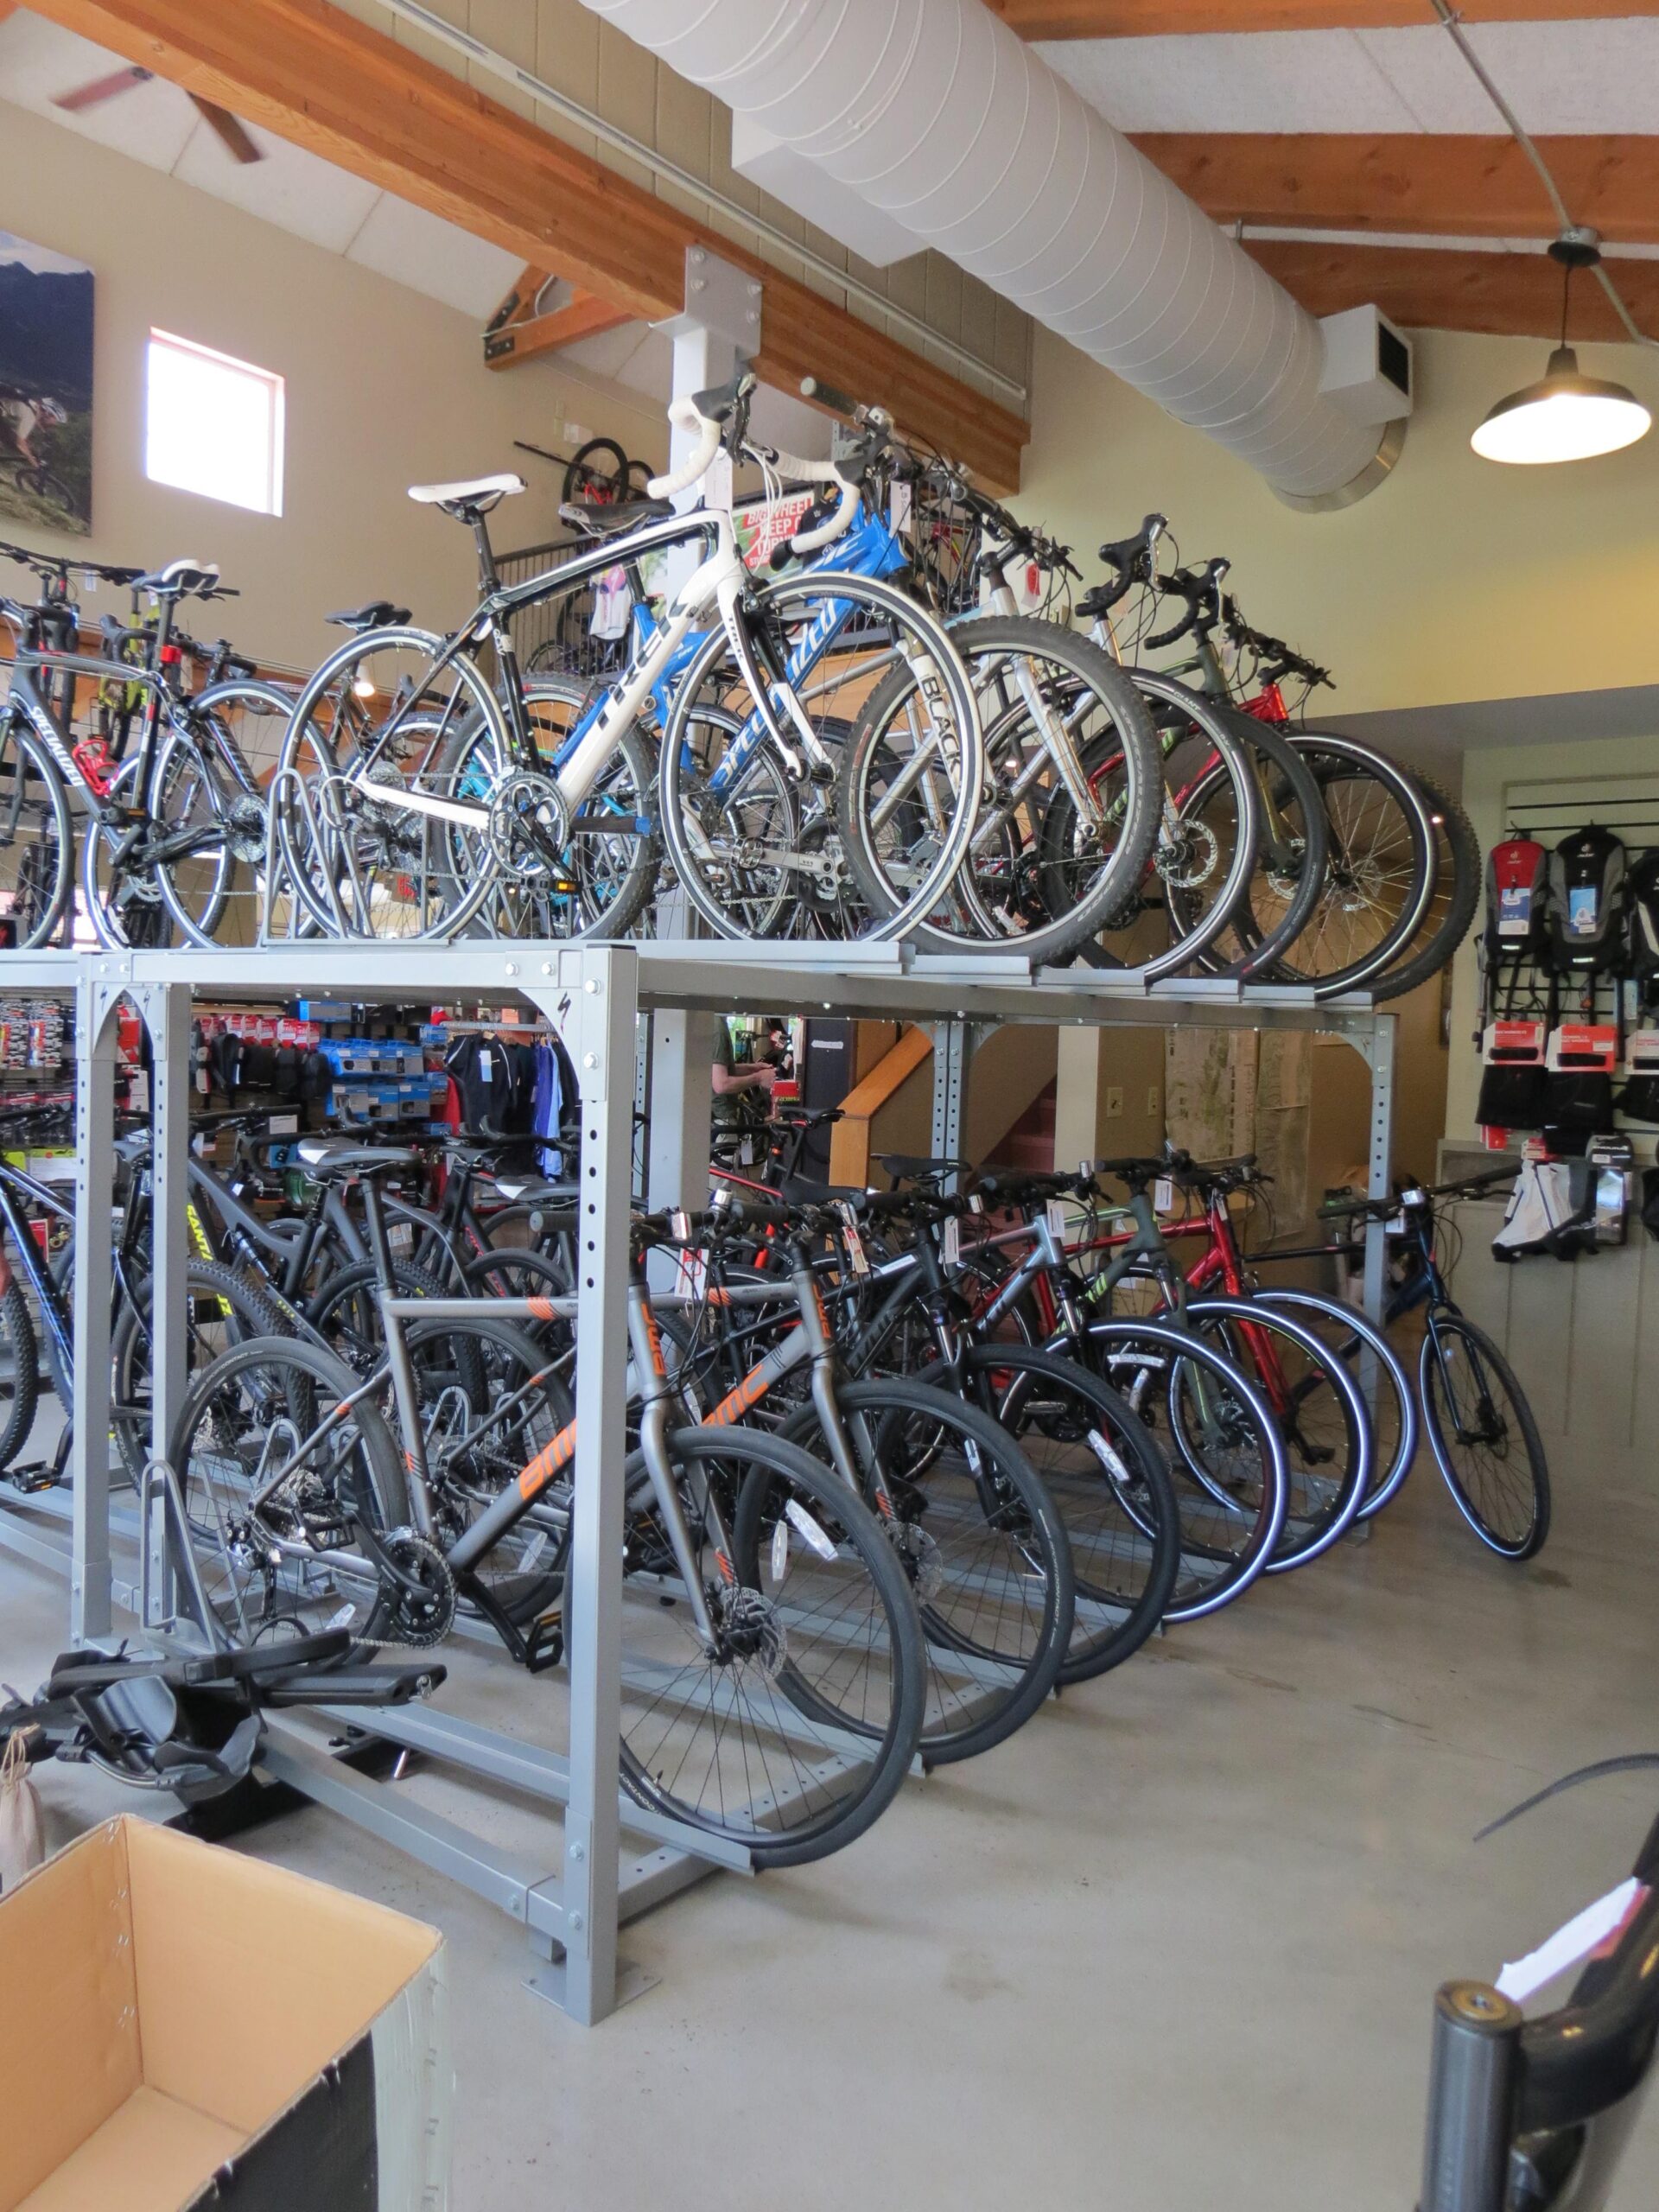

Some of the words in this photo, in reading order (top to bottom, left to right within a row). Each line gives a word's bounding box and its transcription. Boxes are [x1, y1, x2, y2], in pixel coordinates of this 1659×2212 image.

[596, 596, 690, 732] TREK
[31, 705, 86, 787] SPECIALIZED
[921, 677, 961, 775] BLACK
